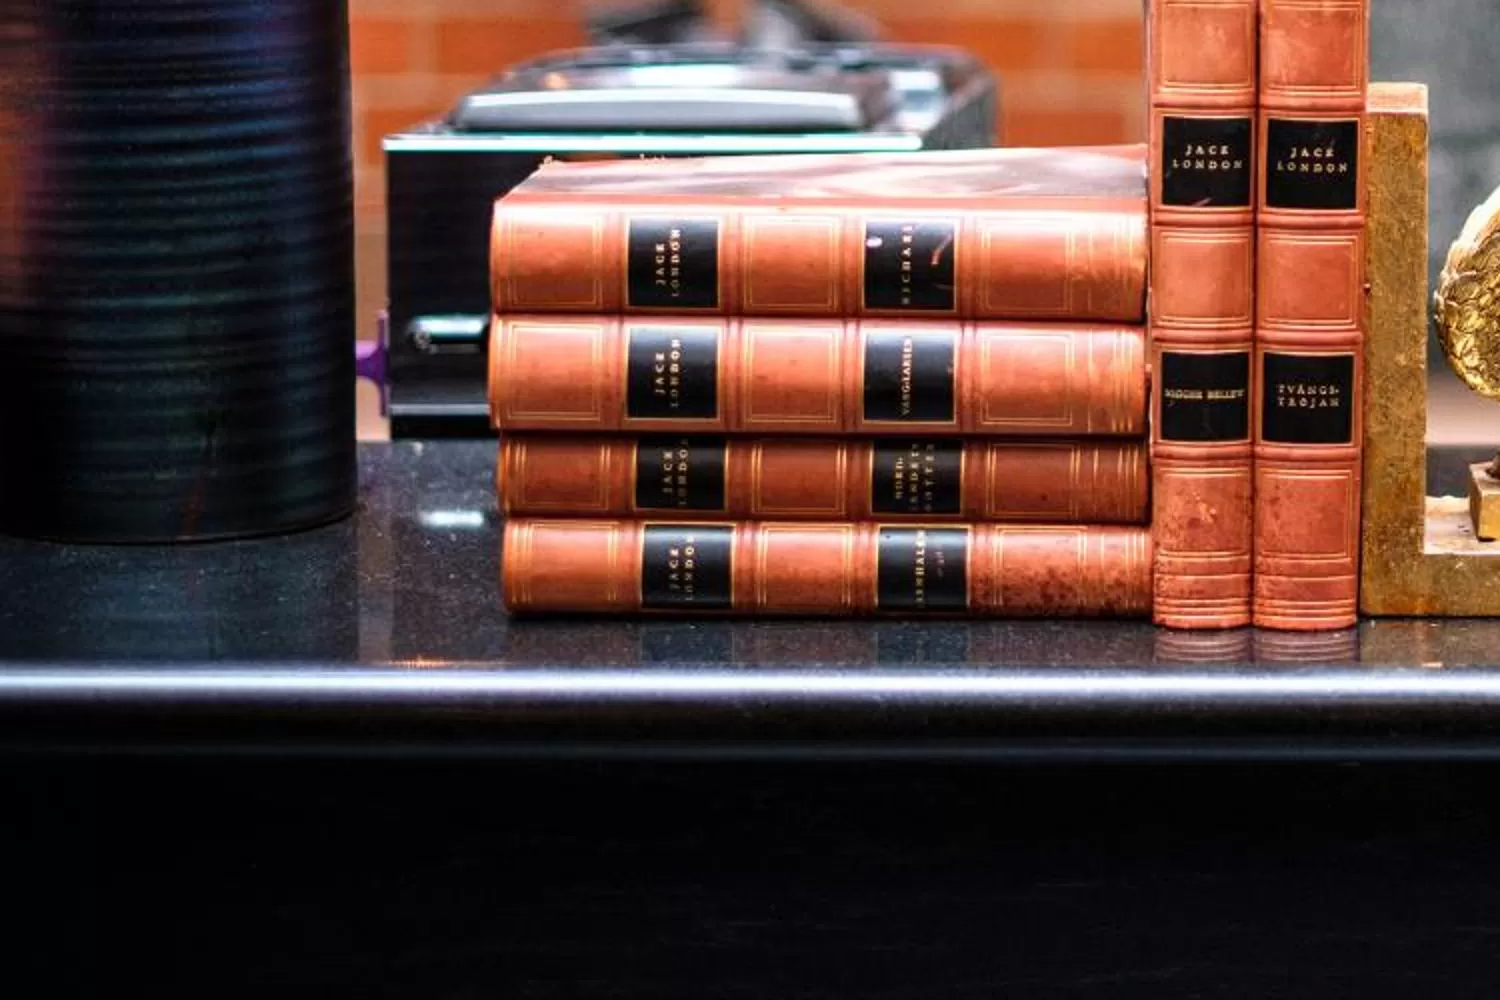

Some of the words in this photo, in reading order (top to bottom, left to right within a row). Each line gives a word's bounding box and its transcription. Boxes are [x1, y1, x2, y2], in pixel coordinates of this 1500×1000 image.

[1172, 159, 1244, 170] LONDON
[1185, 144, 1230, 156] JACK
[1276, 162, 1349, 174] LONDON
[1290, 148, 1335, 158] JACK
[655, 243, 666, 286] JACK
[669, 228, 682, 297] LONDON
[655, 351, 666, 395] JACK
[669, 337, 682, 409] LONDON
[662, 449, 674, 494] JACK
[669, 547, 681, 590] JACK
